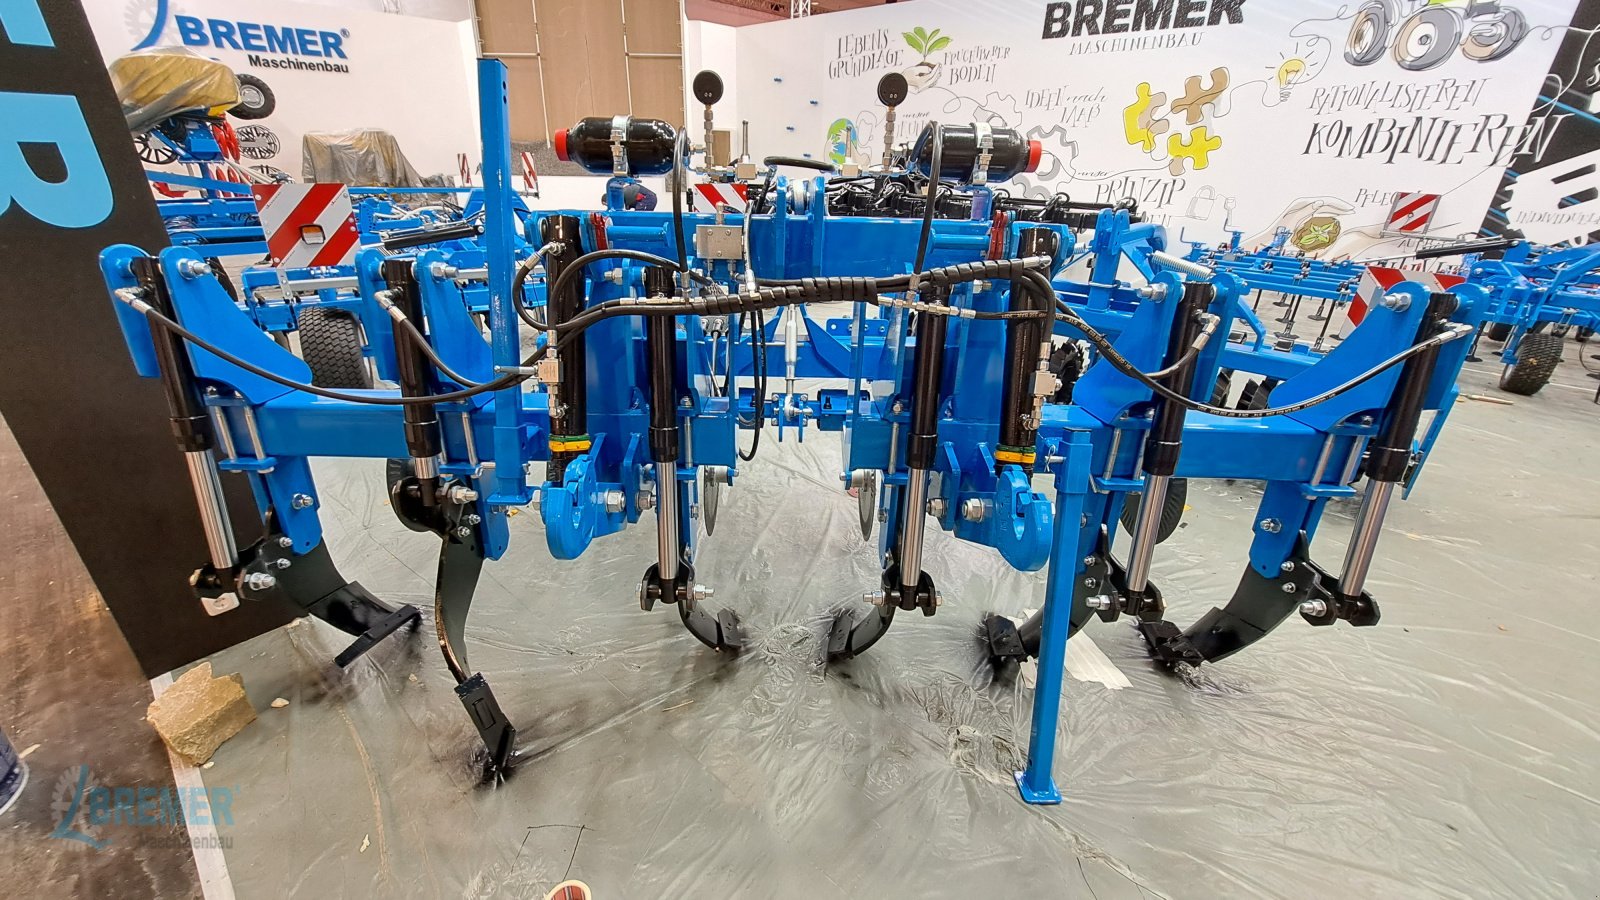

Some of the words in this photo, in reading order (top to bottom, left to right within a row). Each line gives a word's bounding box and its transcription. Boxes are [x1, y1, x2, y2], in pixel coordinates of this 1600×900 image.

[1042, 0, 1246, 40] BREMER
[1069, 32, 1205, 55] MASCHINENBAU
[248, 54, 349, 74] Maschinenbau
[828, 49, 904, 80] GRUNDLAGE
[950, 63, 997, 85] BODEN
[1025, 85, 1068, 112] IDEEN
[1306, 78, 1493, 115] RATIONALISIEREN
[1301, 113, 1575, 167] KOMBINIEREN
[1095, 176, 1187, 209] PRINZIP
